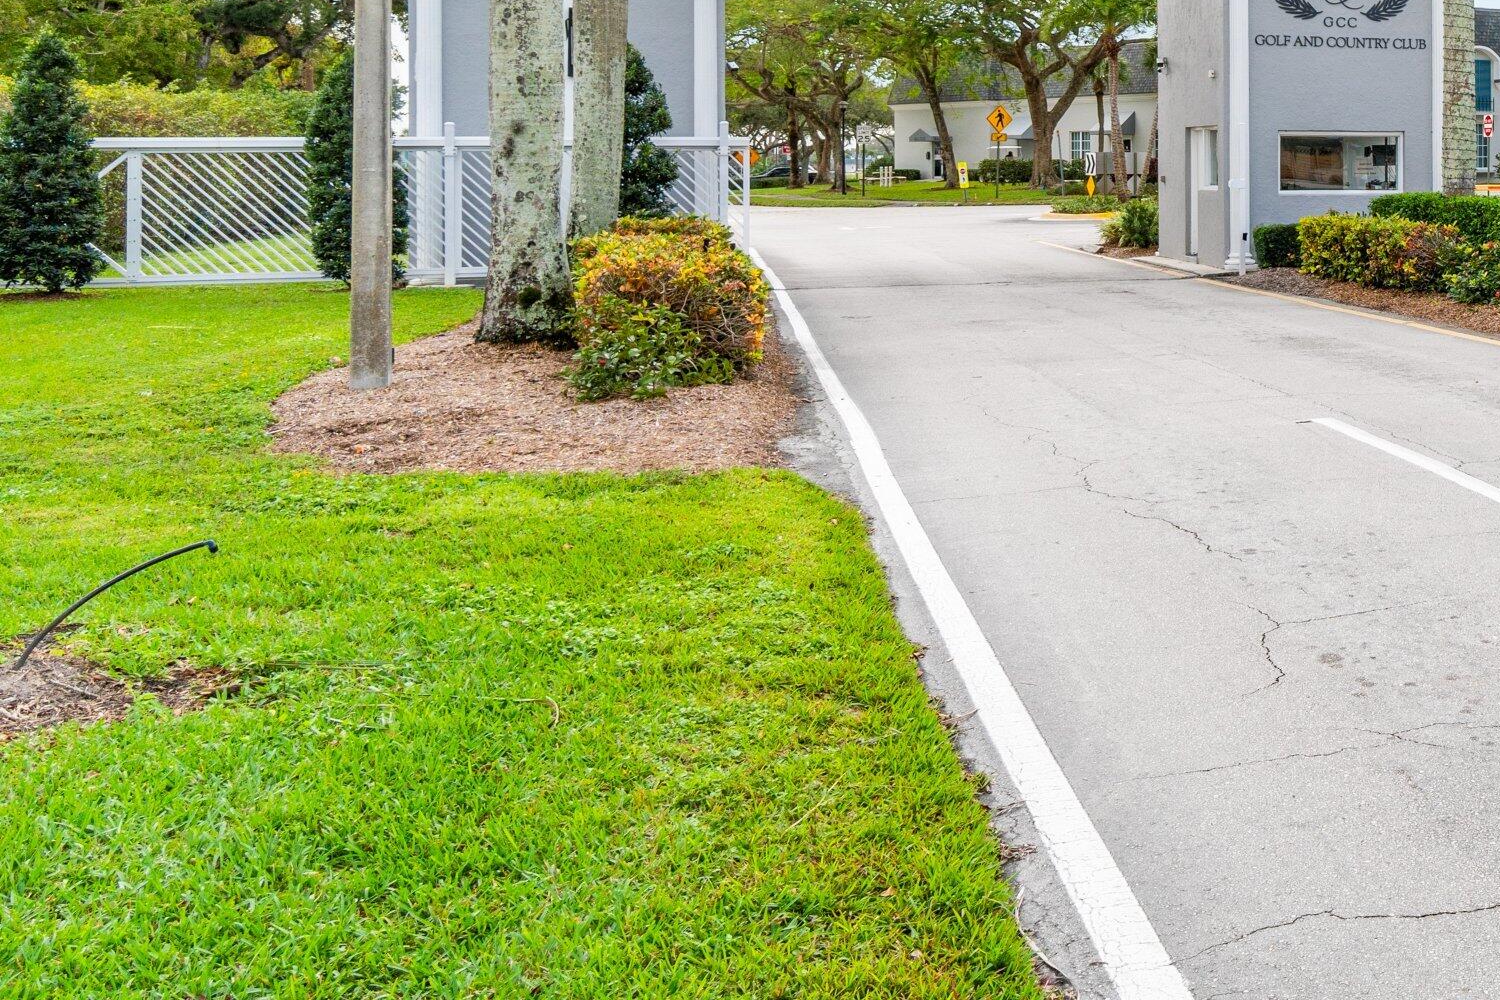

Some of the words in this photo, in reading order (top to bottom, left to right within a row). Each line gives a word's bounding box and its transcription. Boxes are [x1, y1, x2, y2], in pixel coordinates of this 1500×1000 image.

[1323, 16, 1358, 28] GCC
[1254, 34, 1292, 47] GOLF
[1293, 35, 1324, 48] AND
[1326, 36, 1390, 49] COUNTRY
[1392, 38, 1427, 50] CLUB
